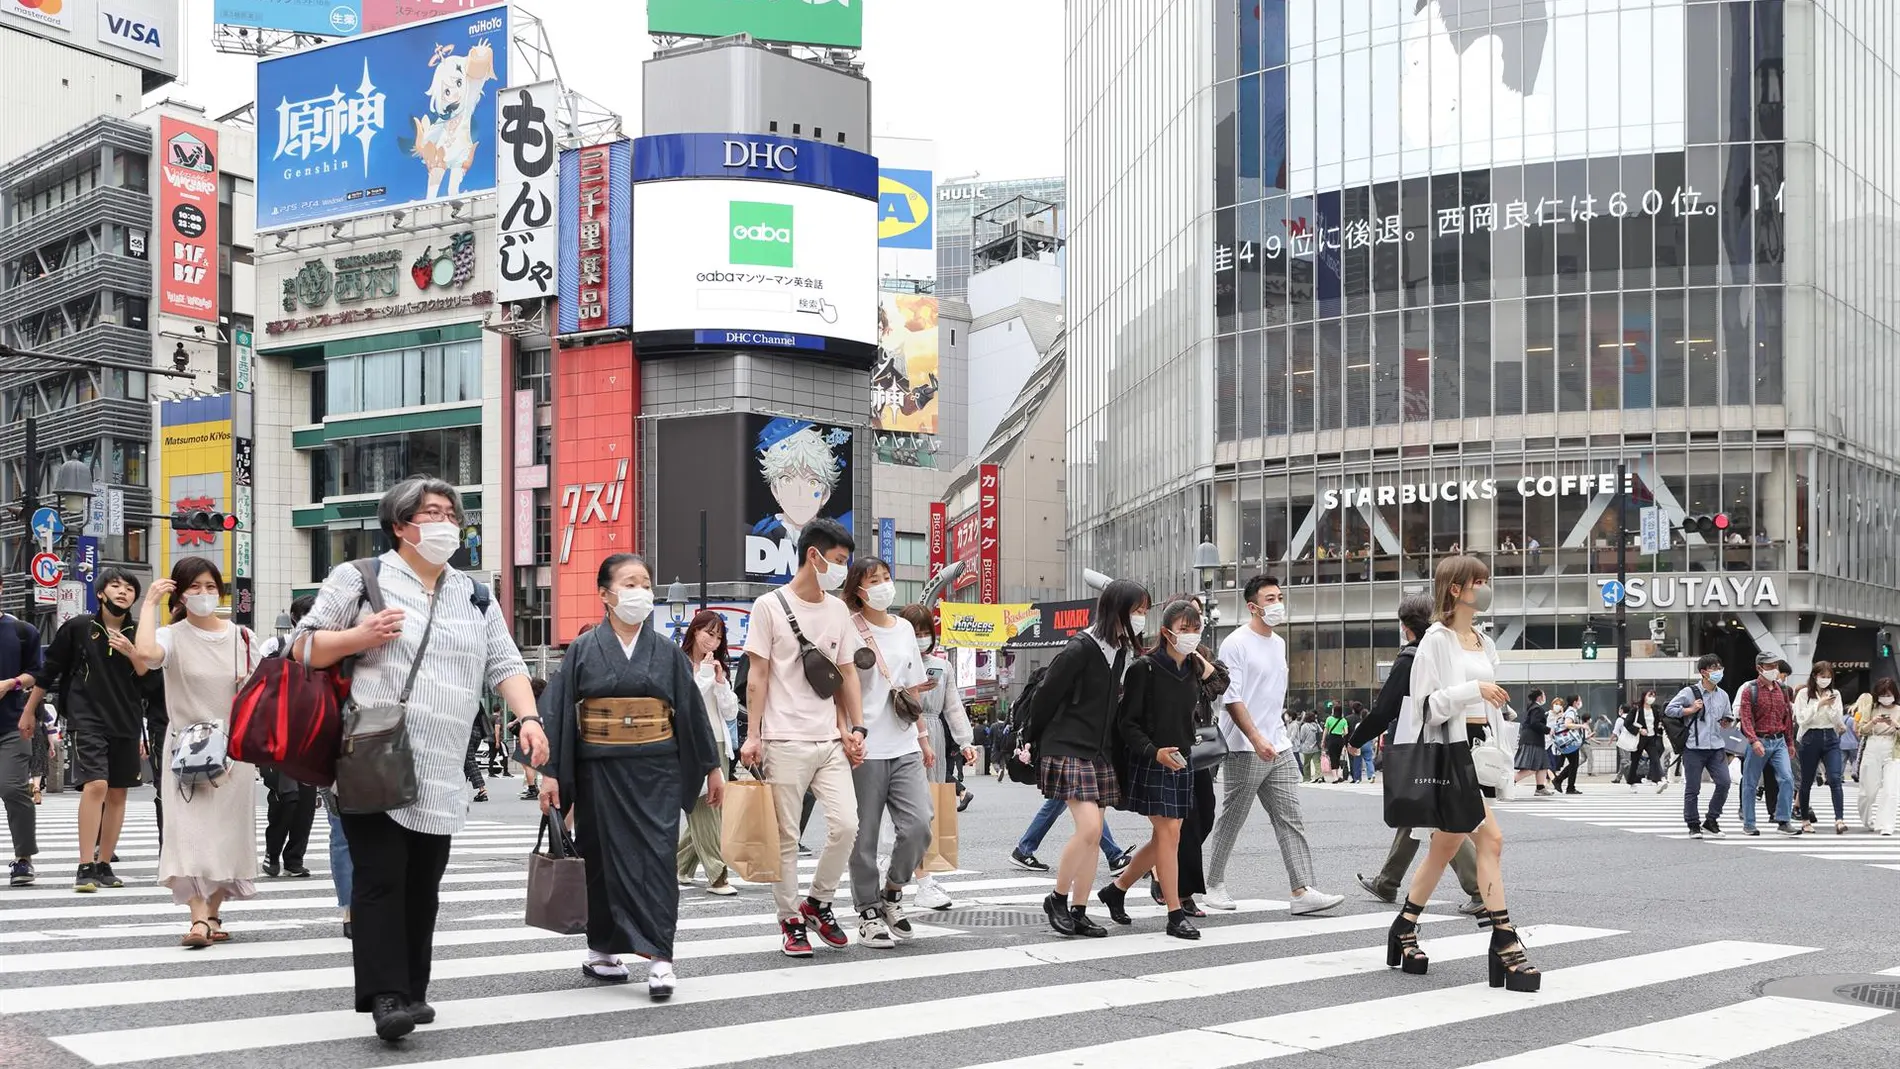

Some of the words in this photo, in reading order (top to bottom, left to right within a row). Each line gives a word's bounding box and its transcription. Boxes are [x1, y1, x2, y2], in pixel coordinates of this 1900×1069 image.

[14, 6, 62, 26] mastercard
[332, 12, 356, 25] 生薬
[469, 17, 502, 35] miHoYo
[103, 12, 162, 48] VISA
[273, 55, 387, 179] 原神
[723, 140, 799, 172] DHC
[283, 159, 349, 181] Genshin
[500, 89, 554, 294] もんじゃ
[941, 185, 988, 201] HULIC
[178, 211, 203, 223] 10:00
[578, 150, 604, 319] 三千里薬品
[733, 221, 791, 243] Gaba
[174, 241, 206, 263] B1F
[173, 262, 207, 285] B2F
[334, 263, 400, 304] 西村
[696, 270, 823, 290] Gabaマンツーマン英会話
[799, 298, 818, 310] 検索
[726, 332, 751, 344] DHC
[752, 333, 796, 346] Channel
[165, 434, 208, 446] Matsumoto
[1323, 478, 1498, 510] STARBUCKS
[1517, 473, 1633, 498] COFFEE
[93, 487, 105, 533] 渋谷駅前
[559, 457, 630, 565] クスリ
[932, 513, 941, 529] BIG
[981, 474, 997, 550] カラオケ
[932, 531, 941, 554] ECHO
[85, 545, 94, 582] MIZO
[982, 559, 992, 578] BIG
[982, 579, 992, 604] ECHO
[952, 614, 994, 633] ROCKERS
[1053, 607, 1089, 630] ALVARK
[1414, 778, 1451, 786] ESPERZA
